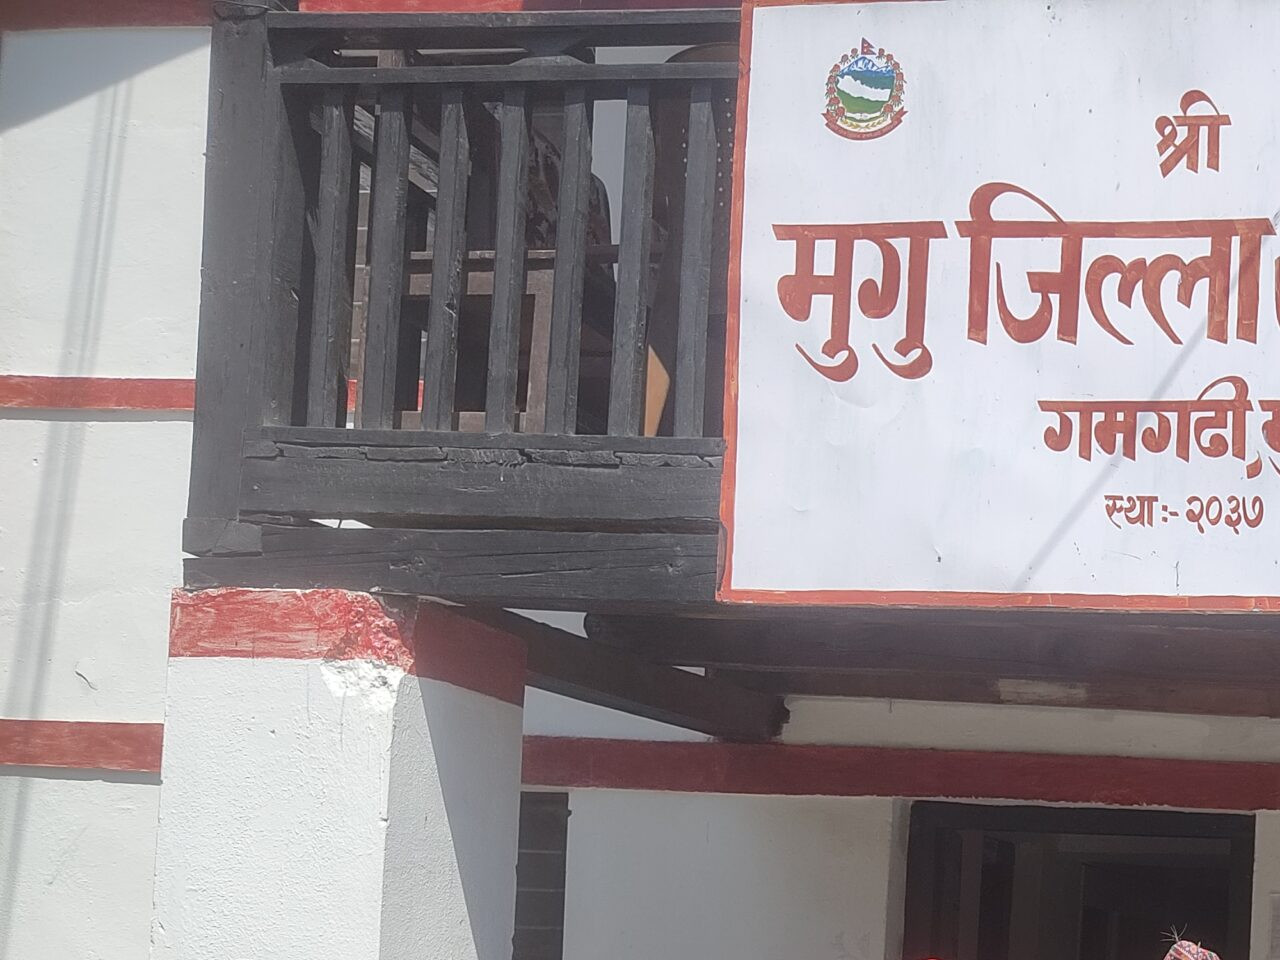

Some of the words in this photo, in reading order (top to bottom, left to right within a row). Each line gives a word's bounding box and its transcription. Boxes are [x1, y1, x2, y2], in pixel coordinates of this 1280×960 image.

[1155, 89, 1231, 178] श्री
[772, 220, 948, 382] मुगु
[955, 182, 1277, 345] जिल्ला
[1185, 495, 1265, 535] २०३७
